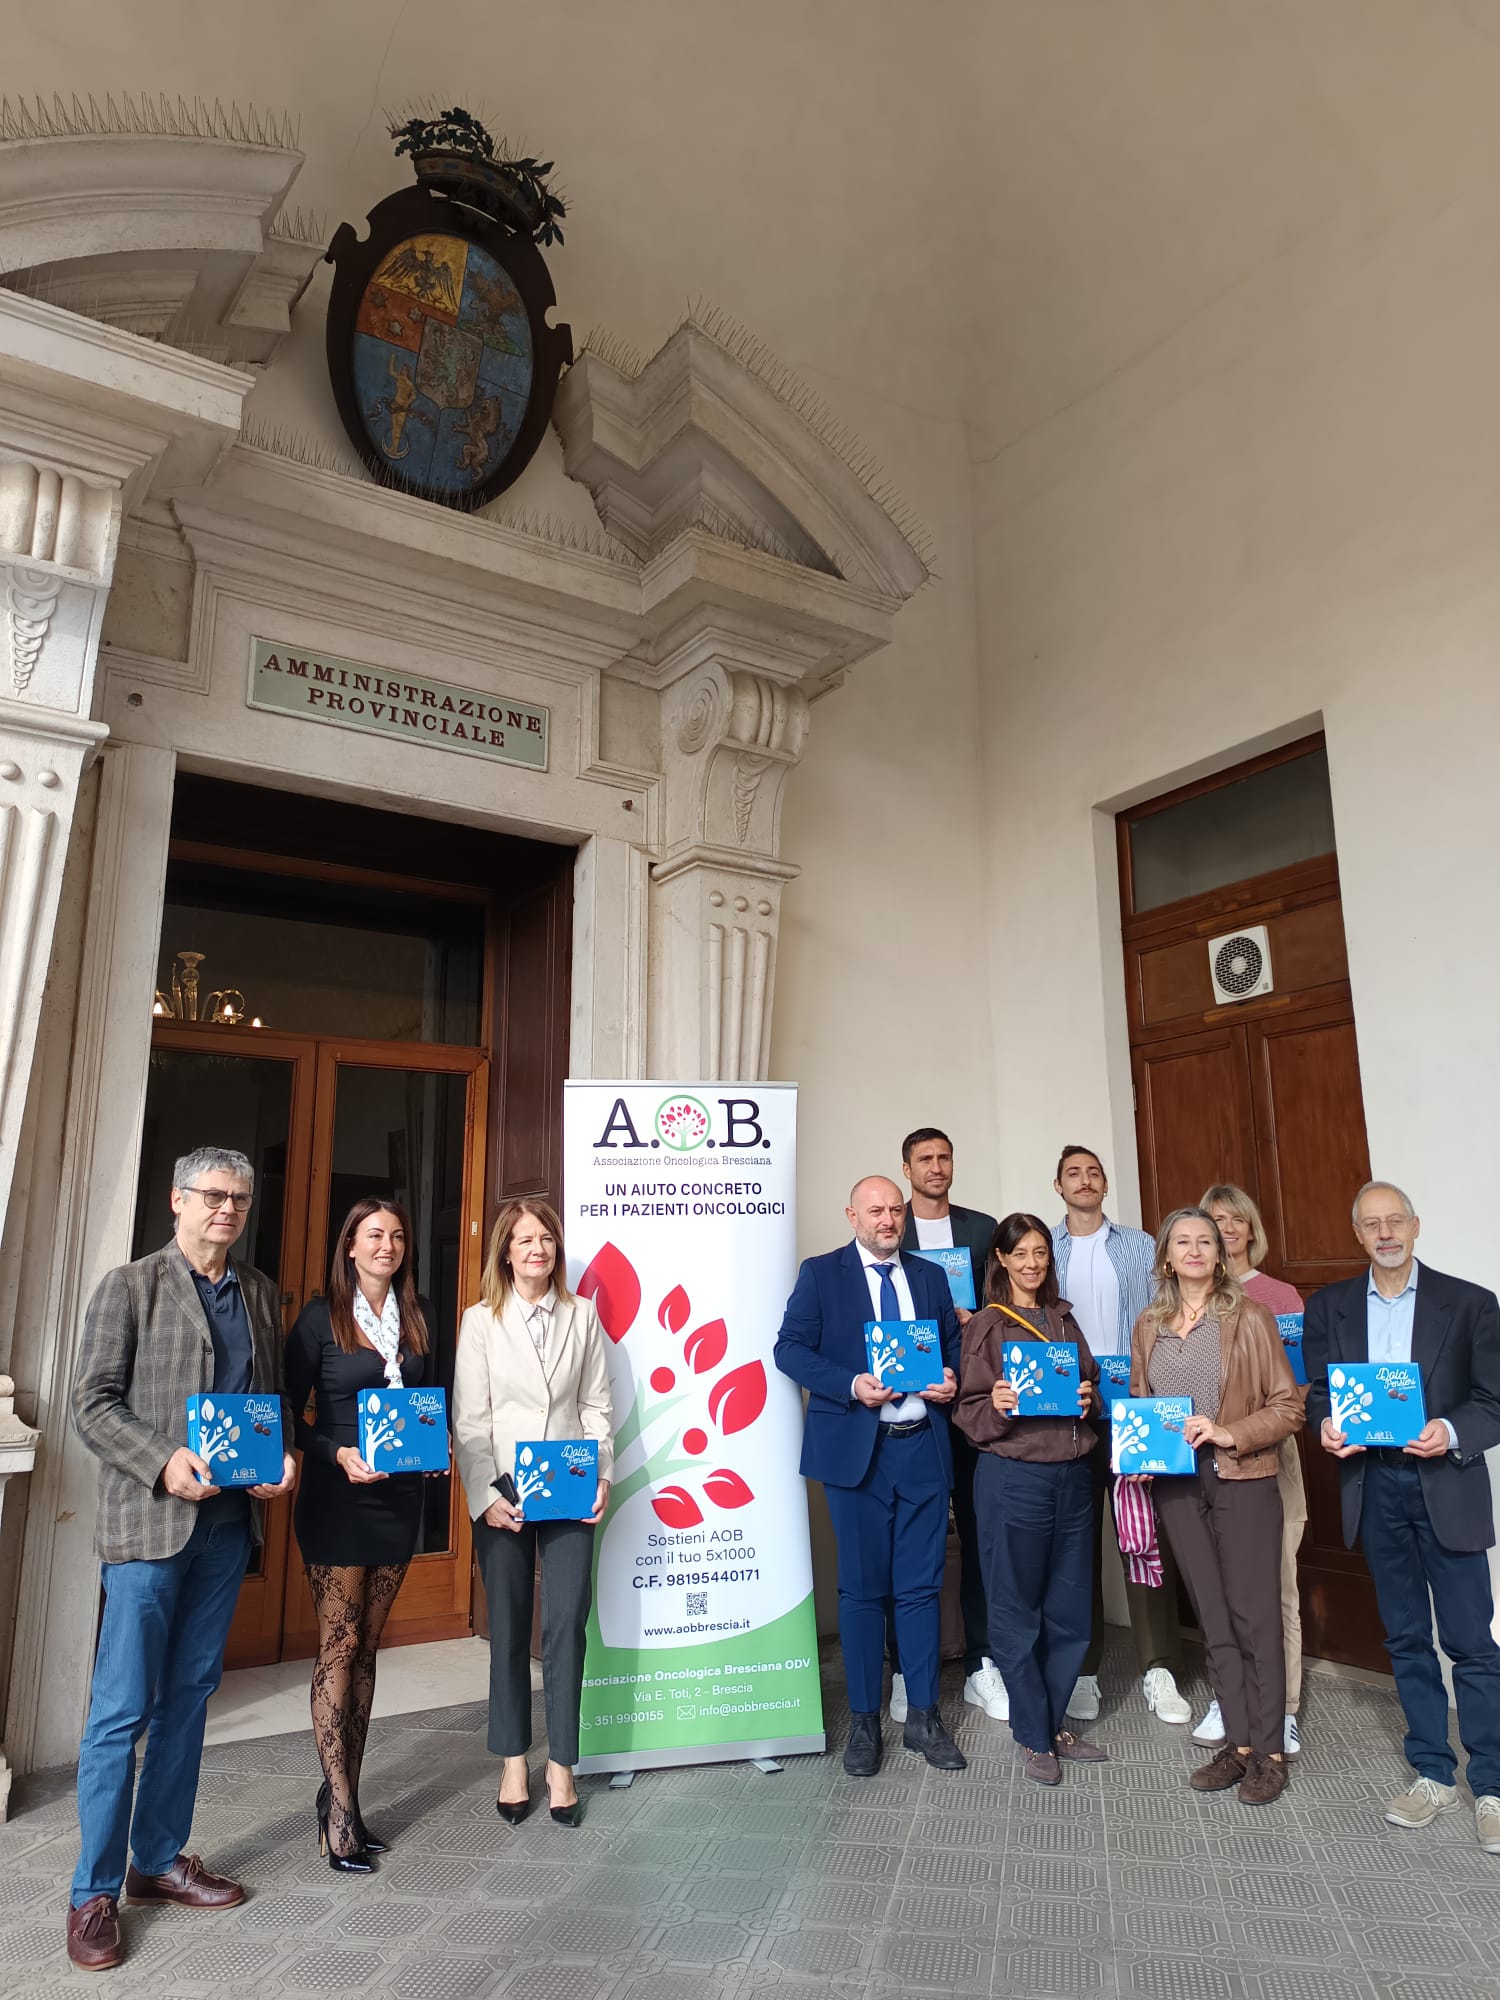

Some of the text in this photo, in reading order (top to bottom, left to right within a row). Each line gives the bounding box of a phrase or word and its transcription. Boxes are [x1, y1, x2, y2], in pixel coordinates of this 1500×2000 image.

[264, 654, 541, 733] AMMINISTRAZIONE
[306, 687, 505, 748] PROVINCIALE
[593, 1155, 772, 1168] Associazione Oncologica Bresciana
[605, 1183, 762, 1196] UN AIUTO CONCRETO
[580, 1202, 785, 1217] PER I PAZIENTI ONCOLOGICI
[1376, 1367, 1409, 1381] Dolci
[244, 1399, 273, 1414] Dolci
[409, 1392, 437, 1405] Dolci
[561, 1444, 589, 1457] Dolci
[648, 1529, 743, 1546] Sostieni AOB
[635, 1547, 755, 1566] con il tuo 5x1000
[632, 1569, 760, 1588] C.F. 98195440171
[644, 1619, 751, 1636] www.aobbrescia.it
[582, 1658, 811, 1688] ssociazione Oncologica Bresciana ODV
[634, 1691, 651, 1702] Via
[656, 1690, 666, 1700] E.
[669, 1688, 691, 1699] Toti,
[695, 1687, 701, 1697] 2
[712, 1682, 753, 1696] Brescia
[700, 1697, 800, 1716] info@aobbrescia.it
[595, 1710, 663, 1726] 351 9900155
